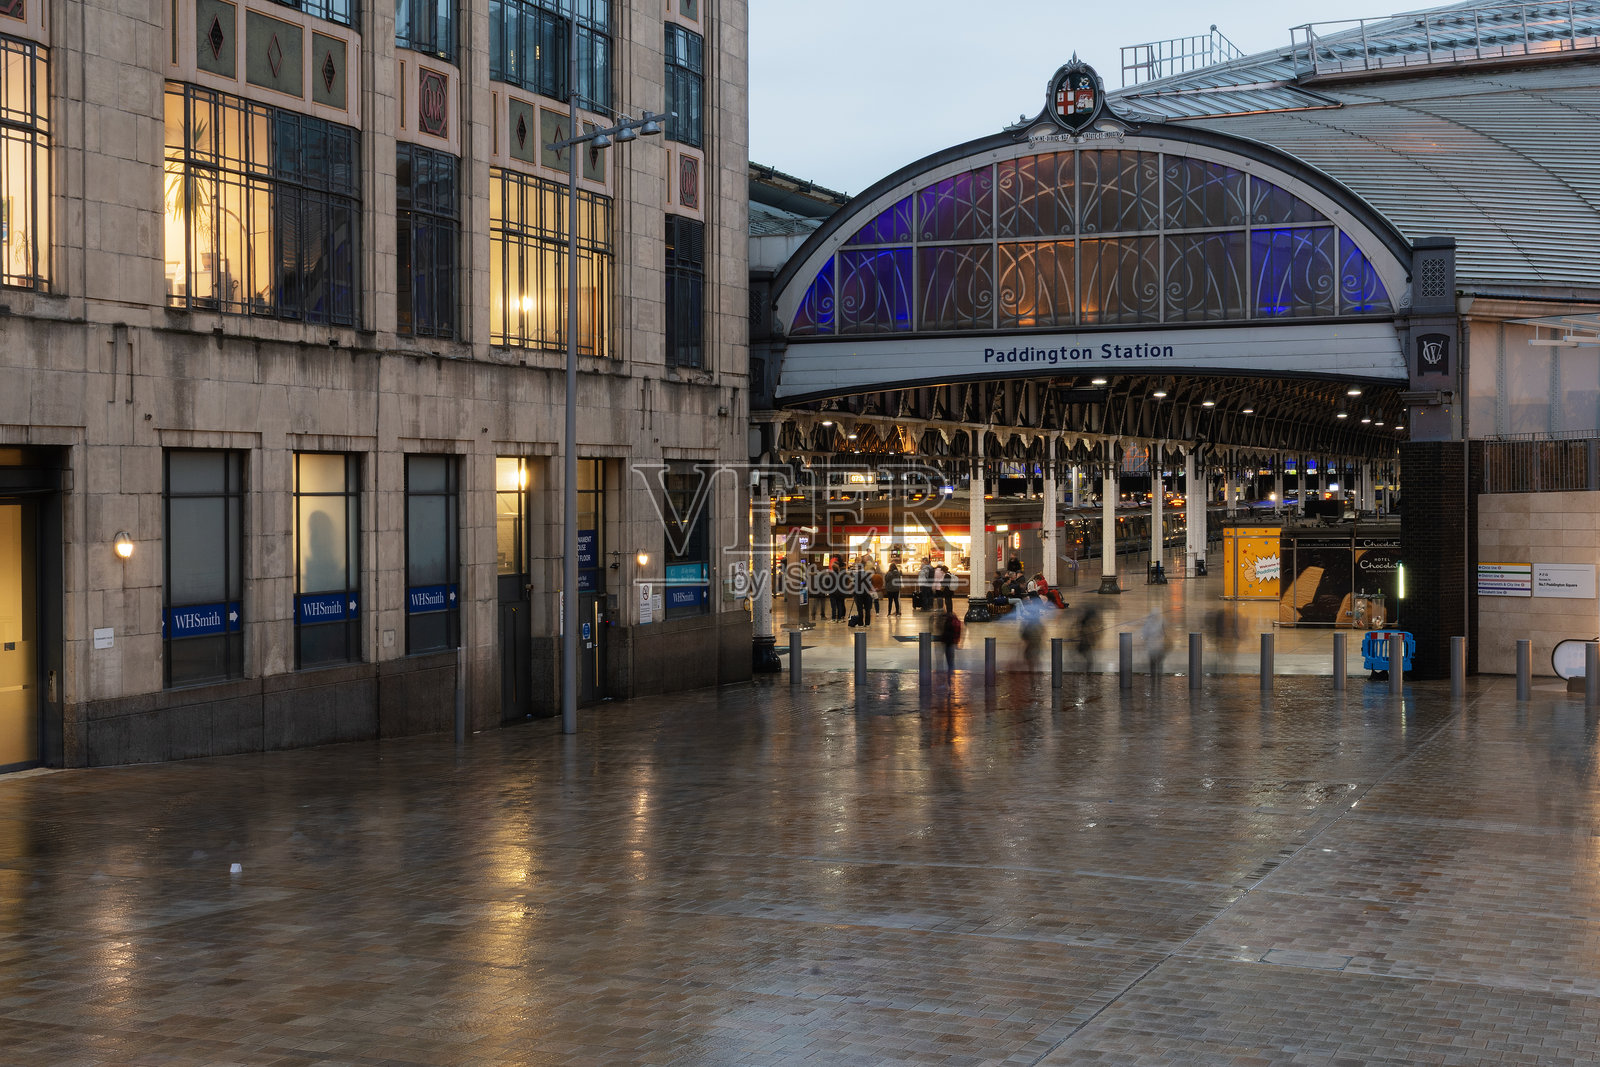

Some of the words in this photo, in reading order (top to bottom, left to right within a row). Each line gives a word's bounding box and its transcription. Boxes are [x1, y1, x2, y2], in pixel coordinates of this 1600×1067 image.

[984, 346, 1092, 364] Paddington
[1101, 342, 1174, 359] Station
[1359, 559, 1399, 569] Chocolat
[411, 589, 444, 606] WHSmith
[303, 600, 342, 617] WHSmith
[174, 611, 221, 630] WHSmith
